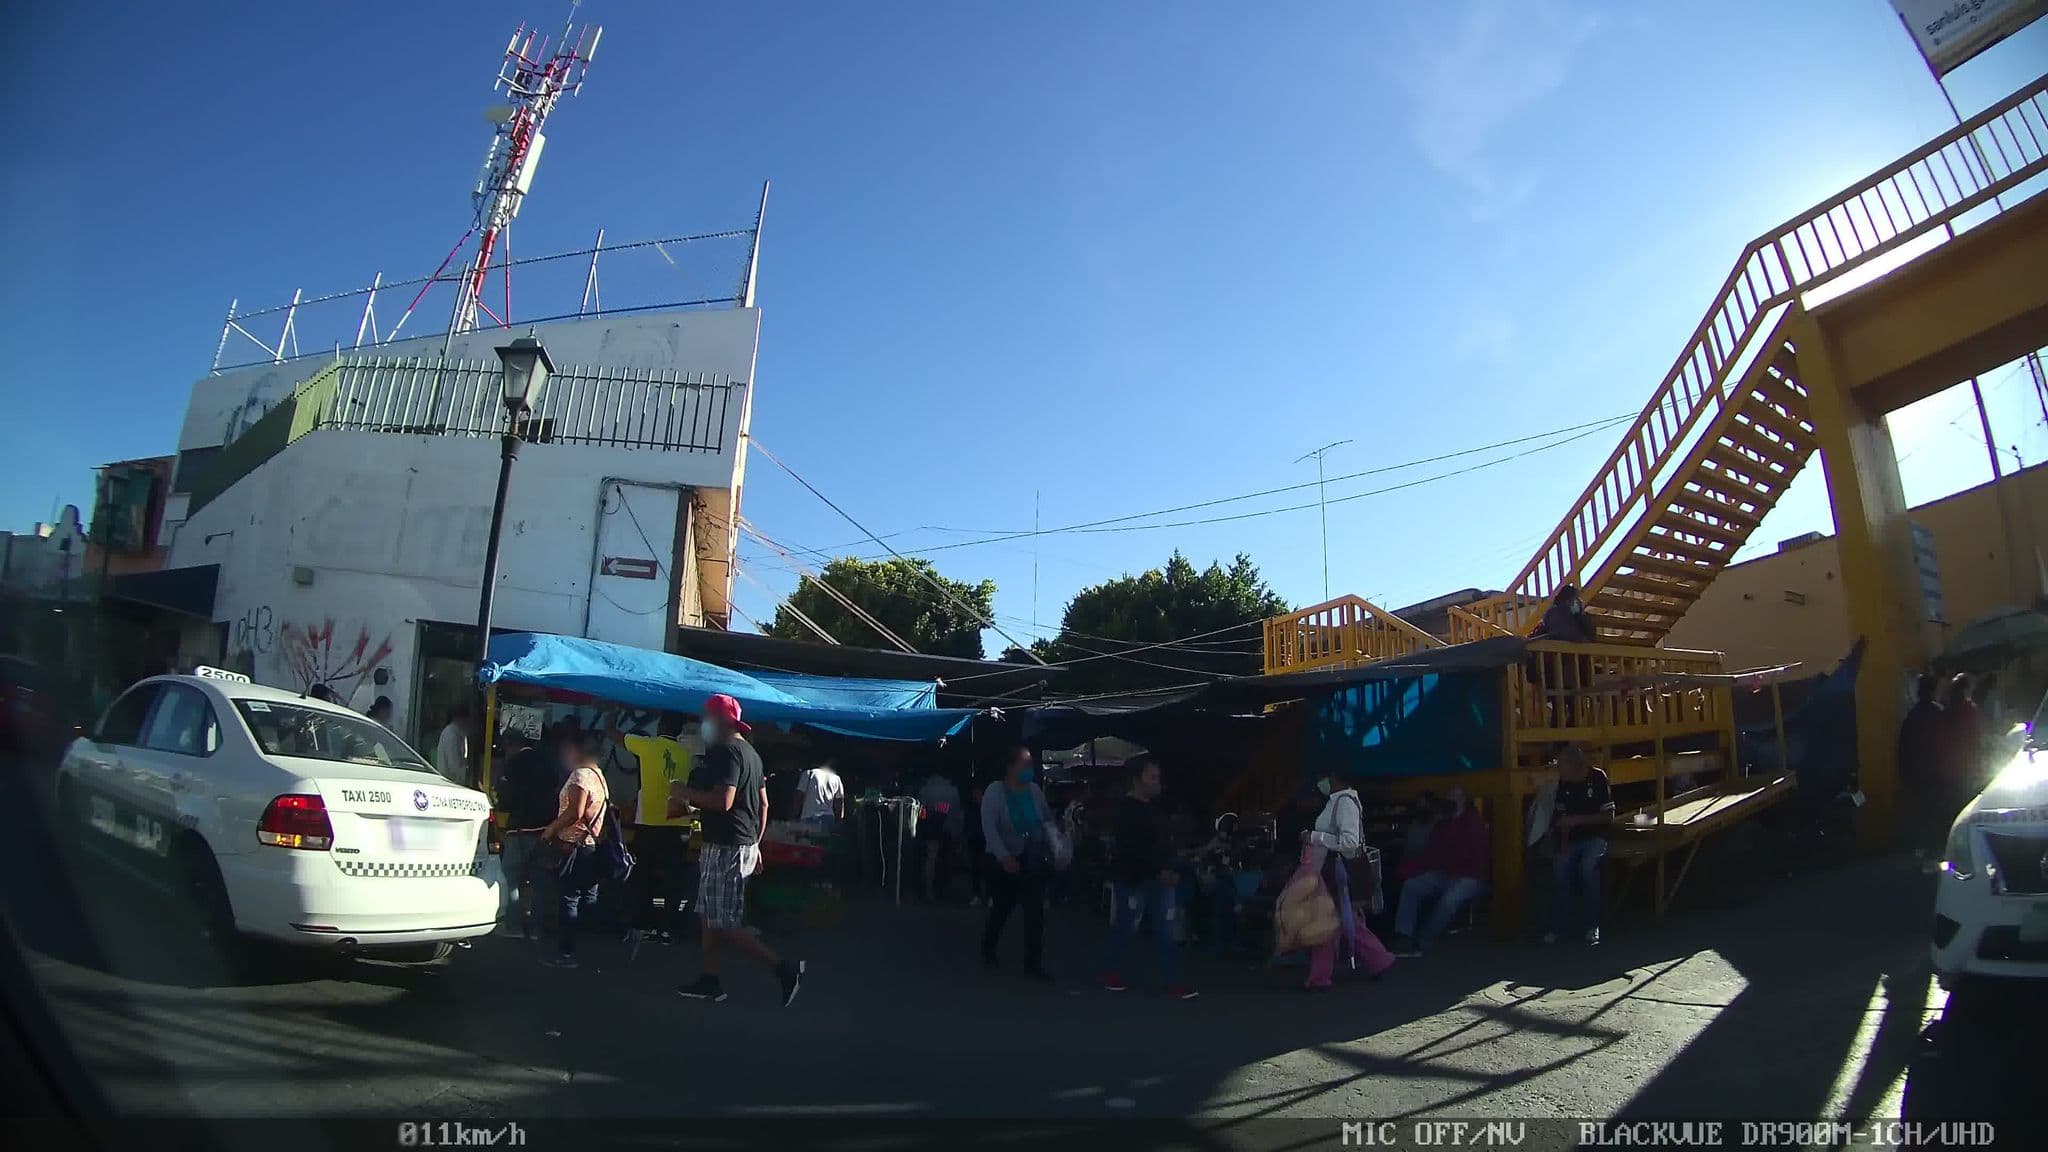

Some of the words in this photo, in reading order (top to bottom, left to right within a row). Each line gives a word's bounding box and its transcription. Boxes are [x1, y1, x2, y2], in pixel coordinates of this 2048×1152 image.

[202, 668, 246, 683] 2500
[342, 790, 367, 802] TAXI
[369, 791, 392, 803] 2500
